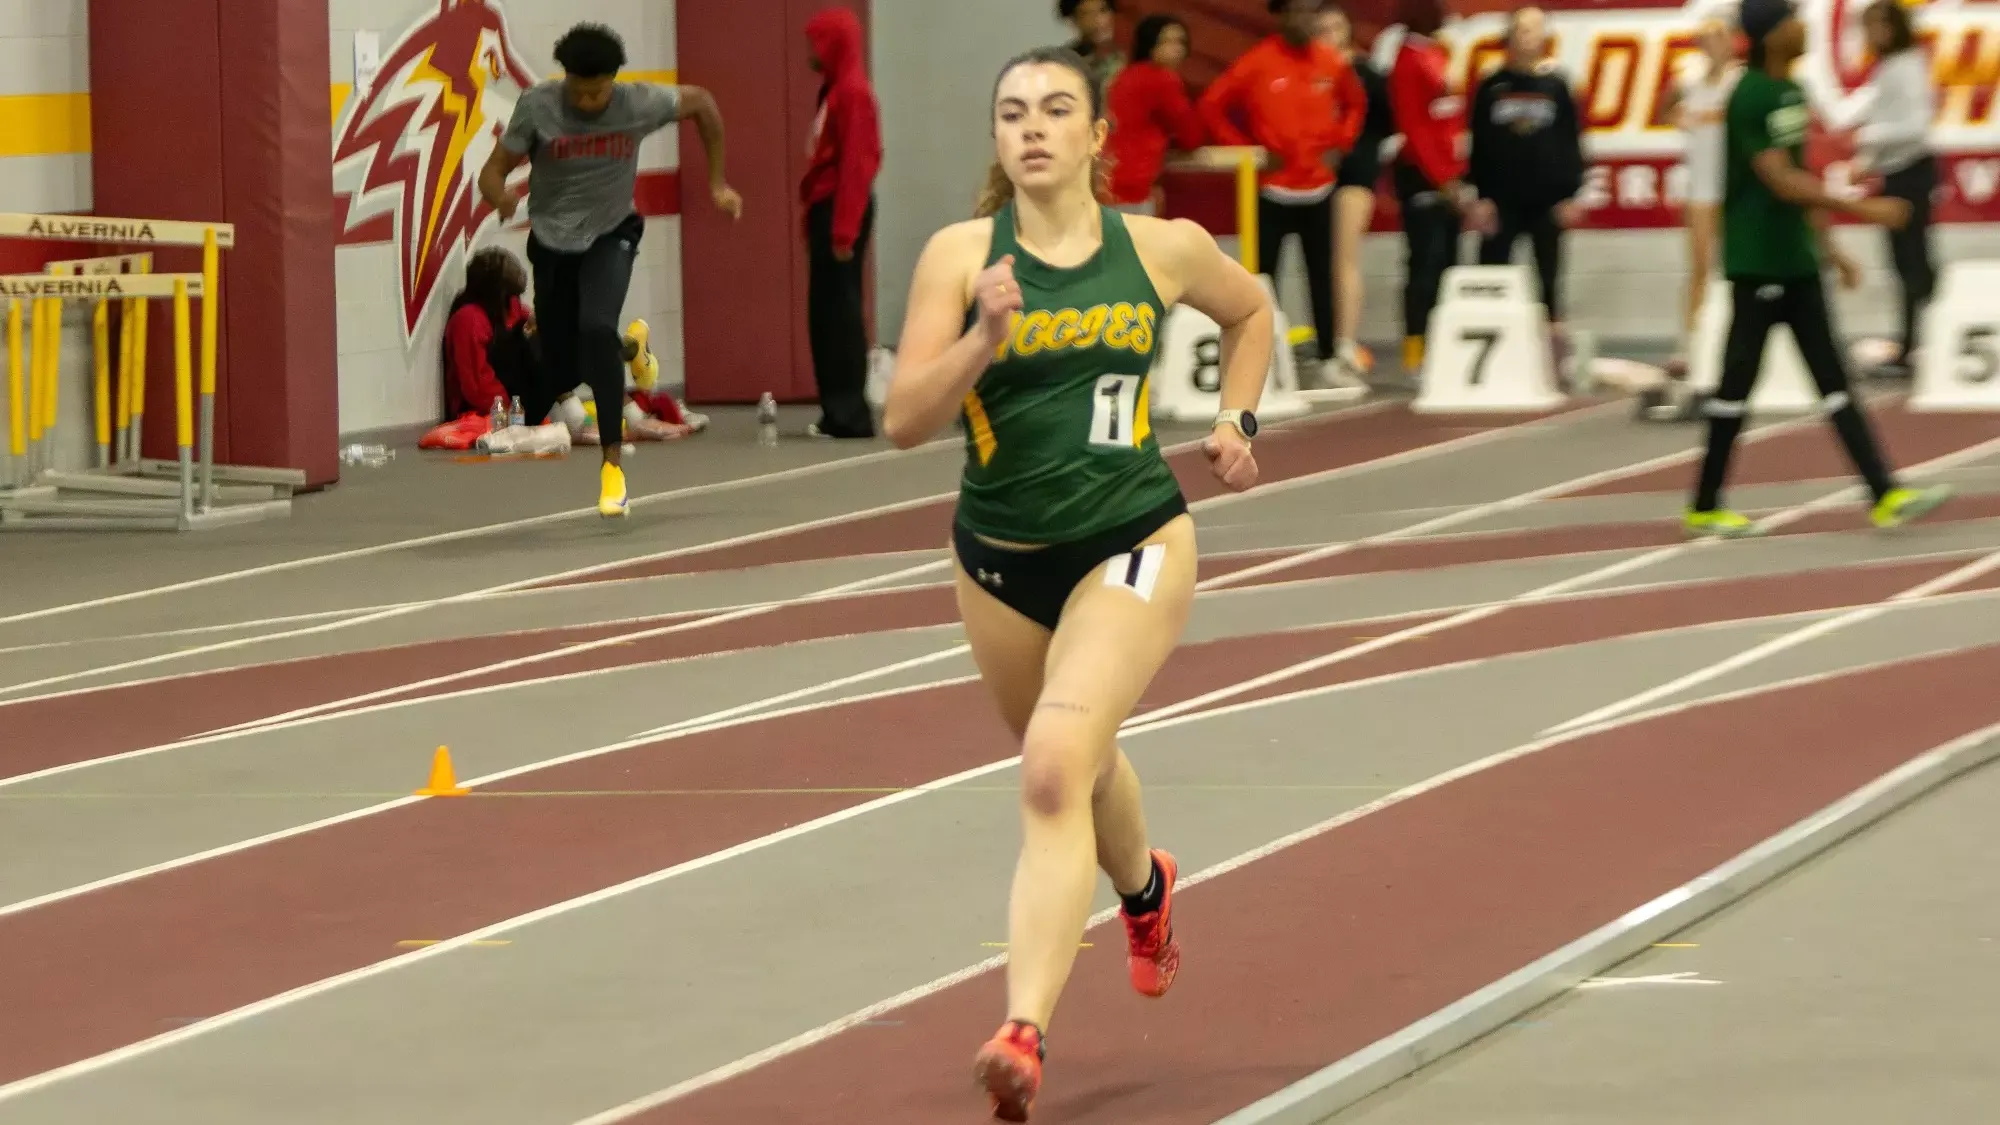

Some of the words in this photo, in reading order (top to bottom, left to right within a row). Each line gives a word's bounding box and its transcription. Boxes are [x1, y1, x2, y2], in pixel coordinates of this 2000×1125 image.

[28, 216, 155, 240] ALVERNIA
[1191, 333, 1221, 394] 8
[1459, 327, 1504, 386] 7
[1955, 324, 2000, 387] 5
[1101, 379, 1124, 440] 1
